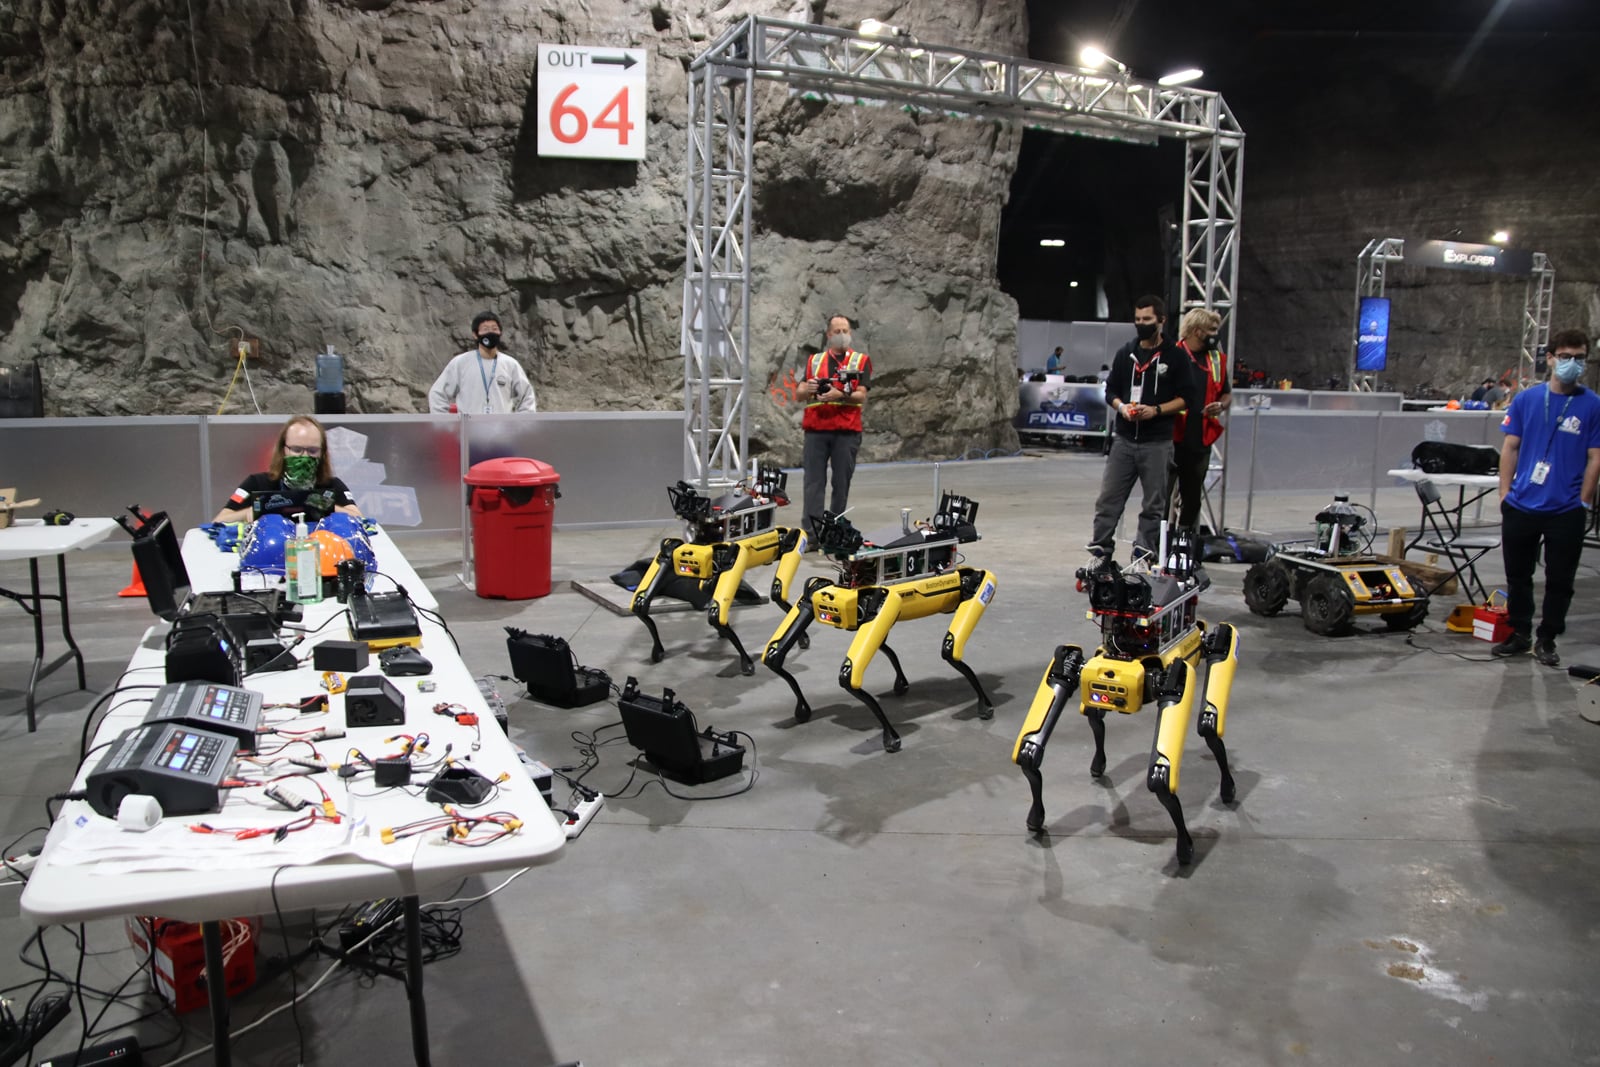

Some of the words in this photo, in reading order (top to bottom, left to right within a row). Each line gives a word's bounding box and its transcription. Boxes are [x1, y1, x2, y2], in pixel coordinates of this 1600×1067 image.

[547, 50, 588, 68] OUT
[549, 82, 634, 146] 64
[1028, 411, 1087, 427] FINALS
[908, 556, 915, 572] 3
